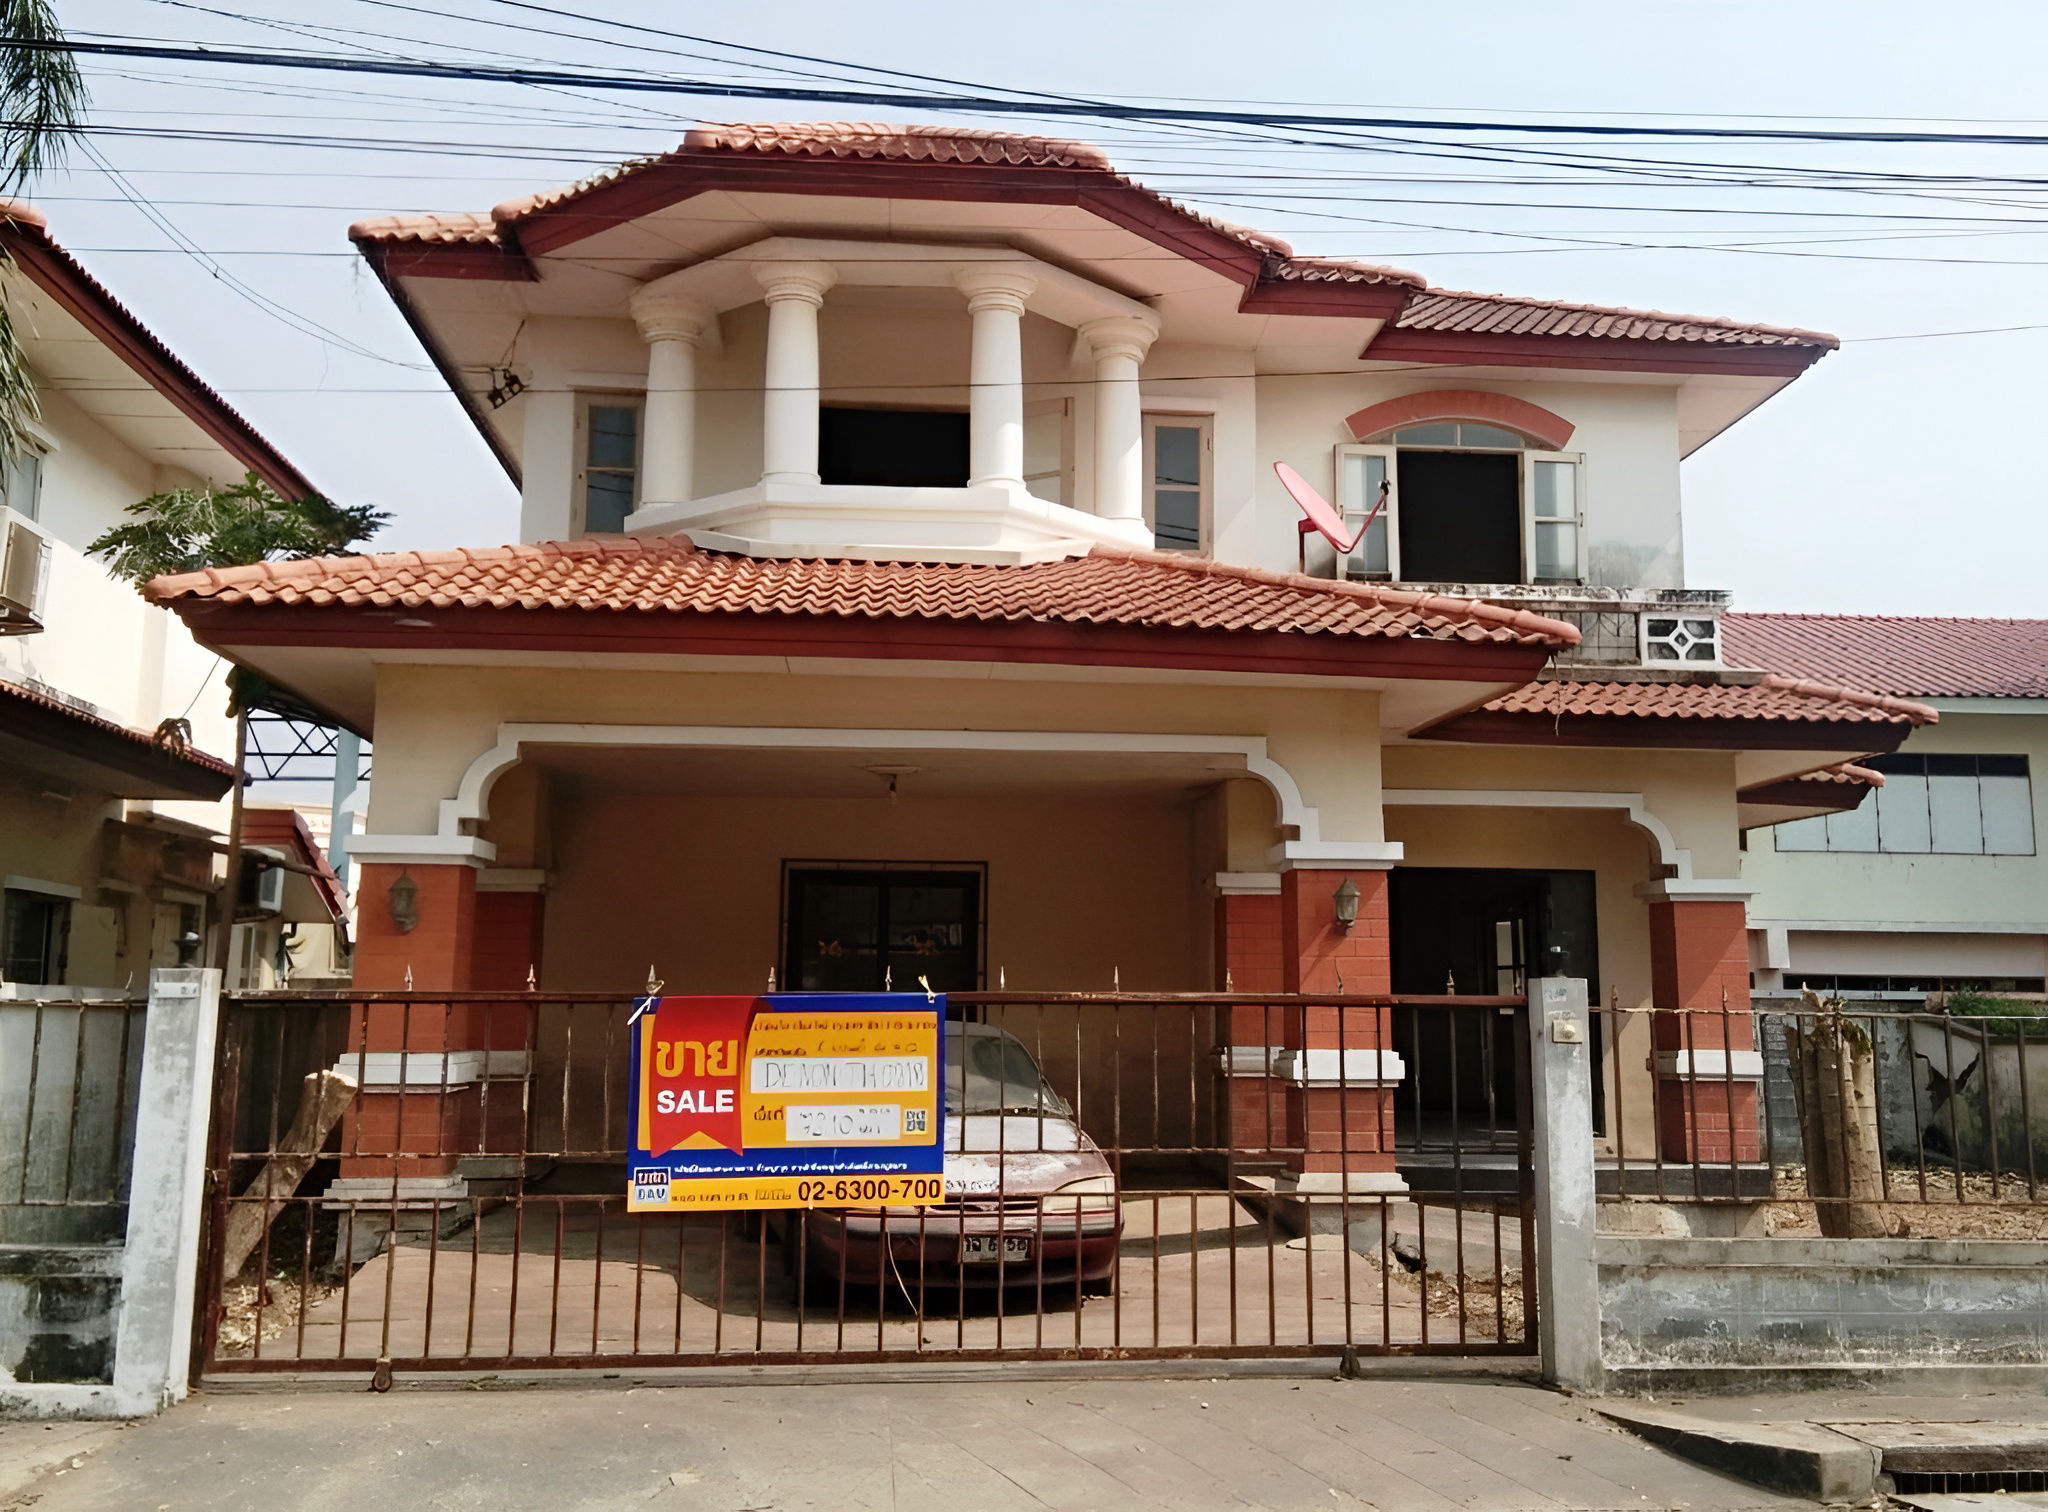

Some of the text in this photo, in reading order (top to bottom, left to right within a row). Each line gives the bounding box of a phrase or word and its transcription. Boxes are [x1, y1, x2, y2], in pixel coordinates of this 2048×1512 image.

[656, 1040, 738, 1078] ขาย
[657, 1089, 734, 1114] SALE
[798, 1179, 941, 1201] 02-6300-700
